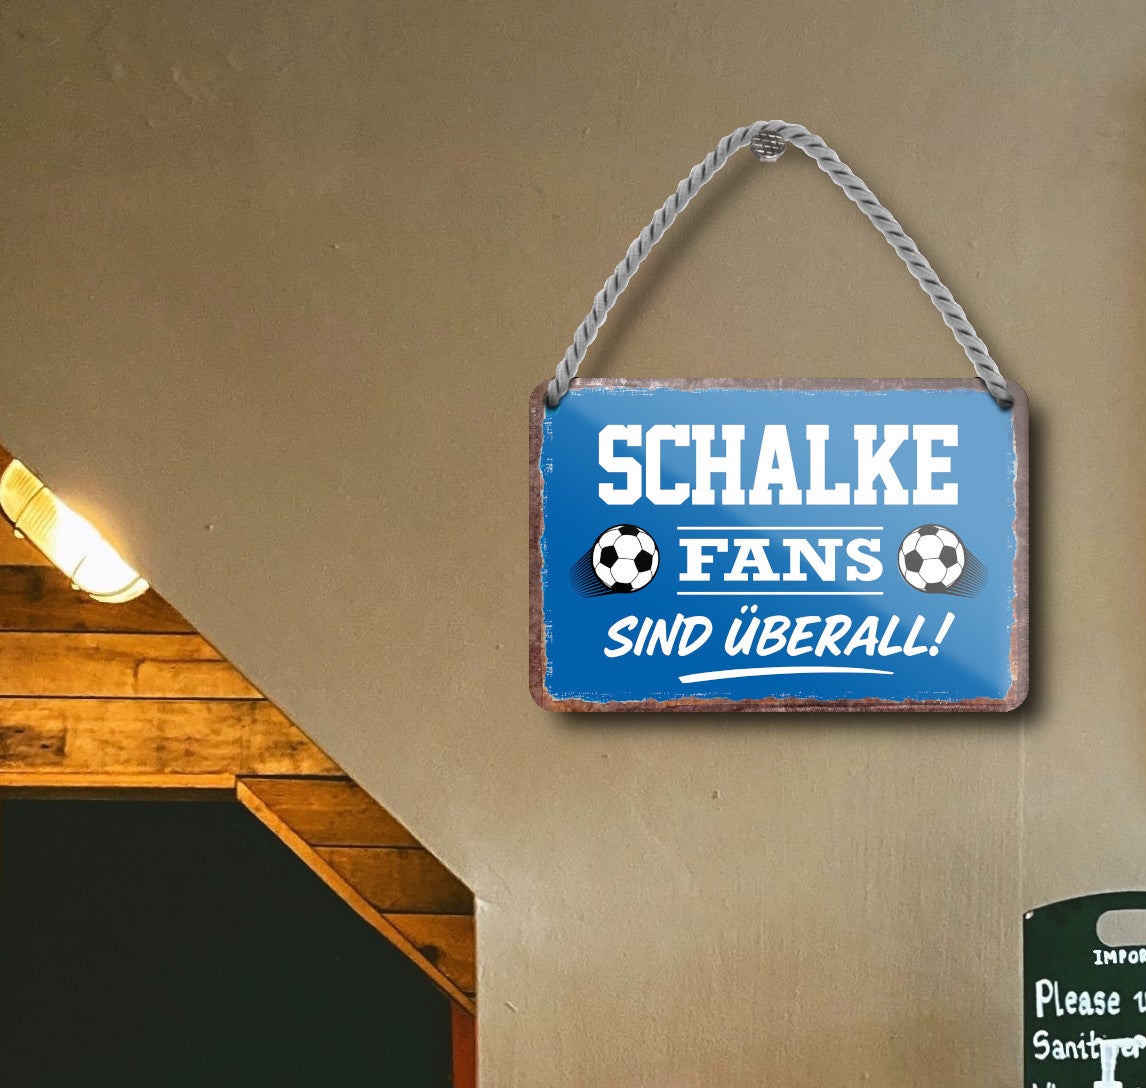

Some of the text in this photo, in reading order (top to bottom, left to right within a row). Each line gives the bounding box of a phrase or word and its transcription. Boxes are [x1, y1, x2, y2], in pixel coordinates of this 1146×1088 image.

[598, 424, 959, 506] SCHALKE
[678, 538, 884, 582] FANS
[604, 604, 956, 658] SIND ÜBERALL!
[1035, 978, 1121, 1018] Please
[1033, 1030, 1146, 1060] Saniter
